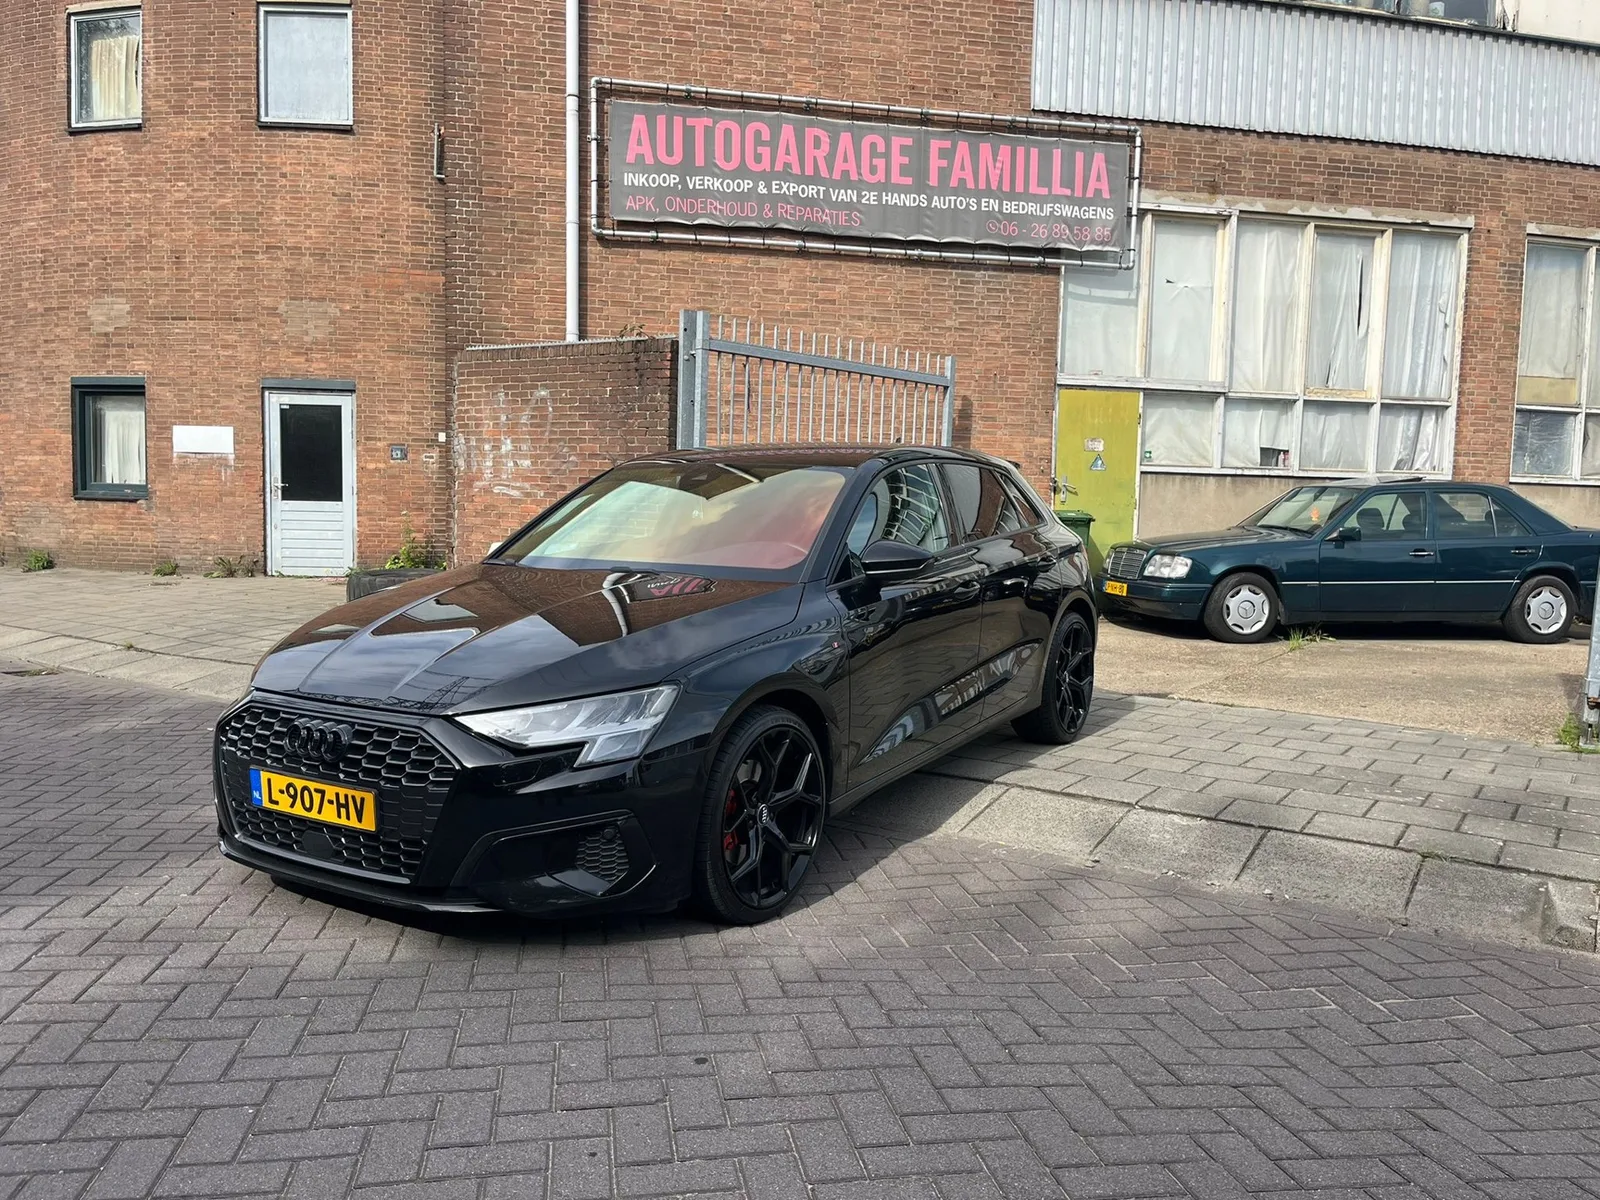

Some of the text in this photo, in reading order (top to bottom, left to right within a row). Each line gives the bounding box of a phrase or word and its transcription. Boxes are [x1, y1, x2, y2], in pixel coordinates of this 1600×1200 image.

[626, 114, 1111, 199] AUTOGARAGE FAMILLIA
[623, 172, 1114, 220] INKOOP, VERKOOP & EXPORT VAN 2E HANDS AUTO'S EN BEDRIJFSWAGENS
[626, 195, 861, 227] APK, ONDERHOUD & REPARATIES
[1000, 221, 1018, 236] 06
[1030, 223, 1048, 239] 26
[1052, 223, 1070, 239] 89
[1074, 226, 1091, 241] 58
[1094, 226, 1112, 242] 85
[253, 778, 366, 824] NL L-907-HV
